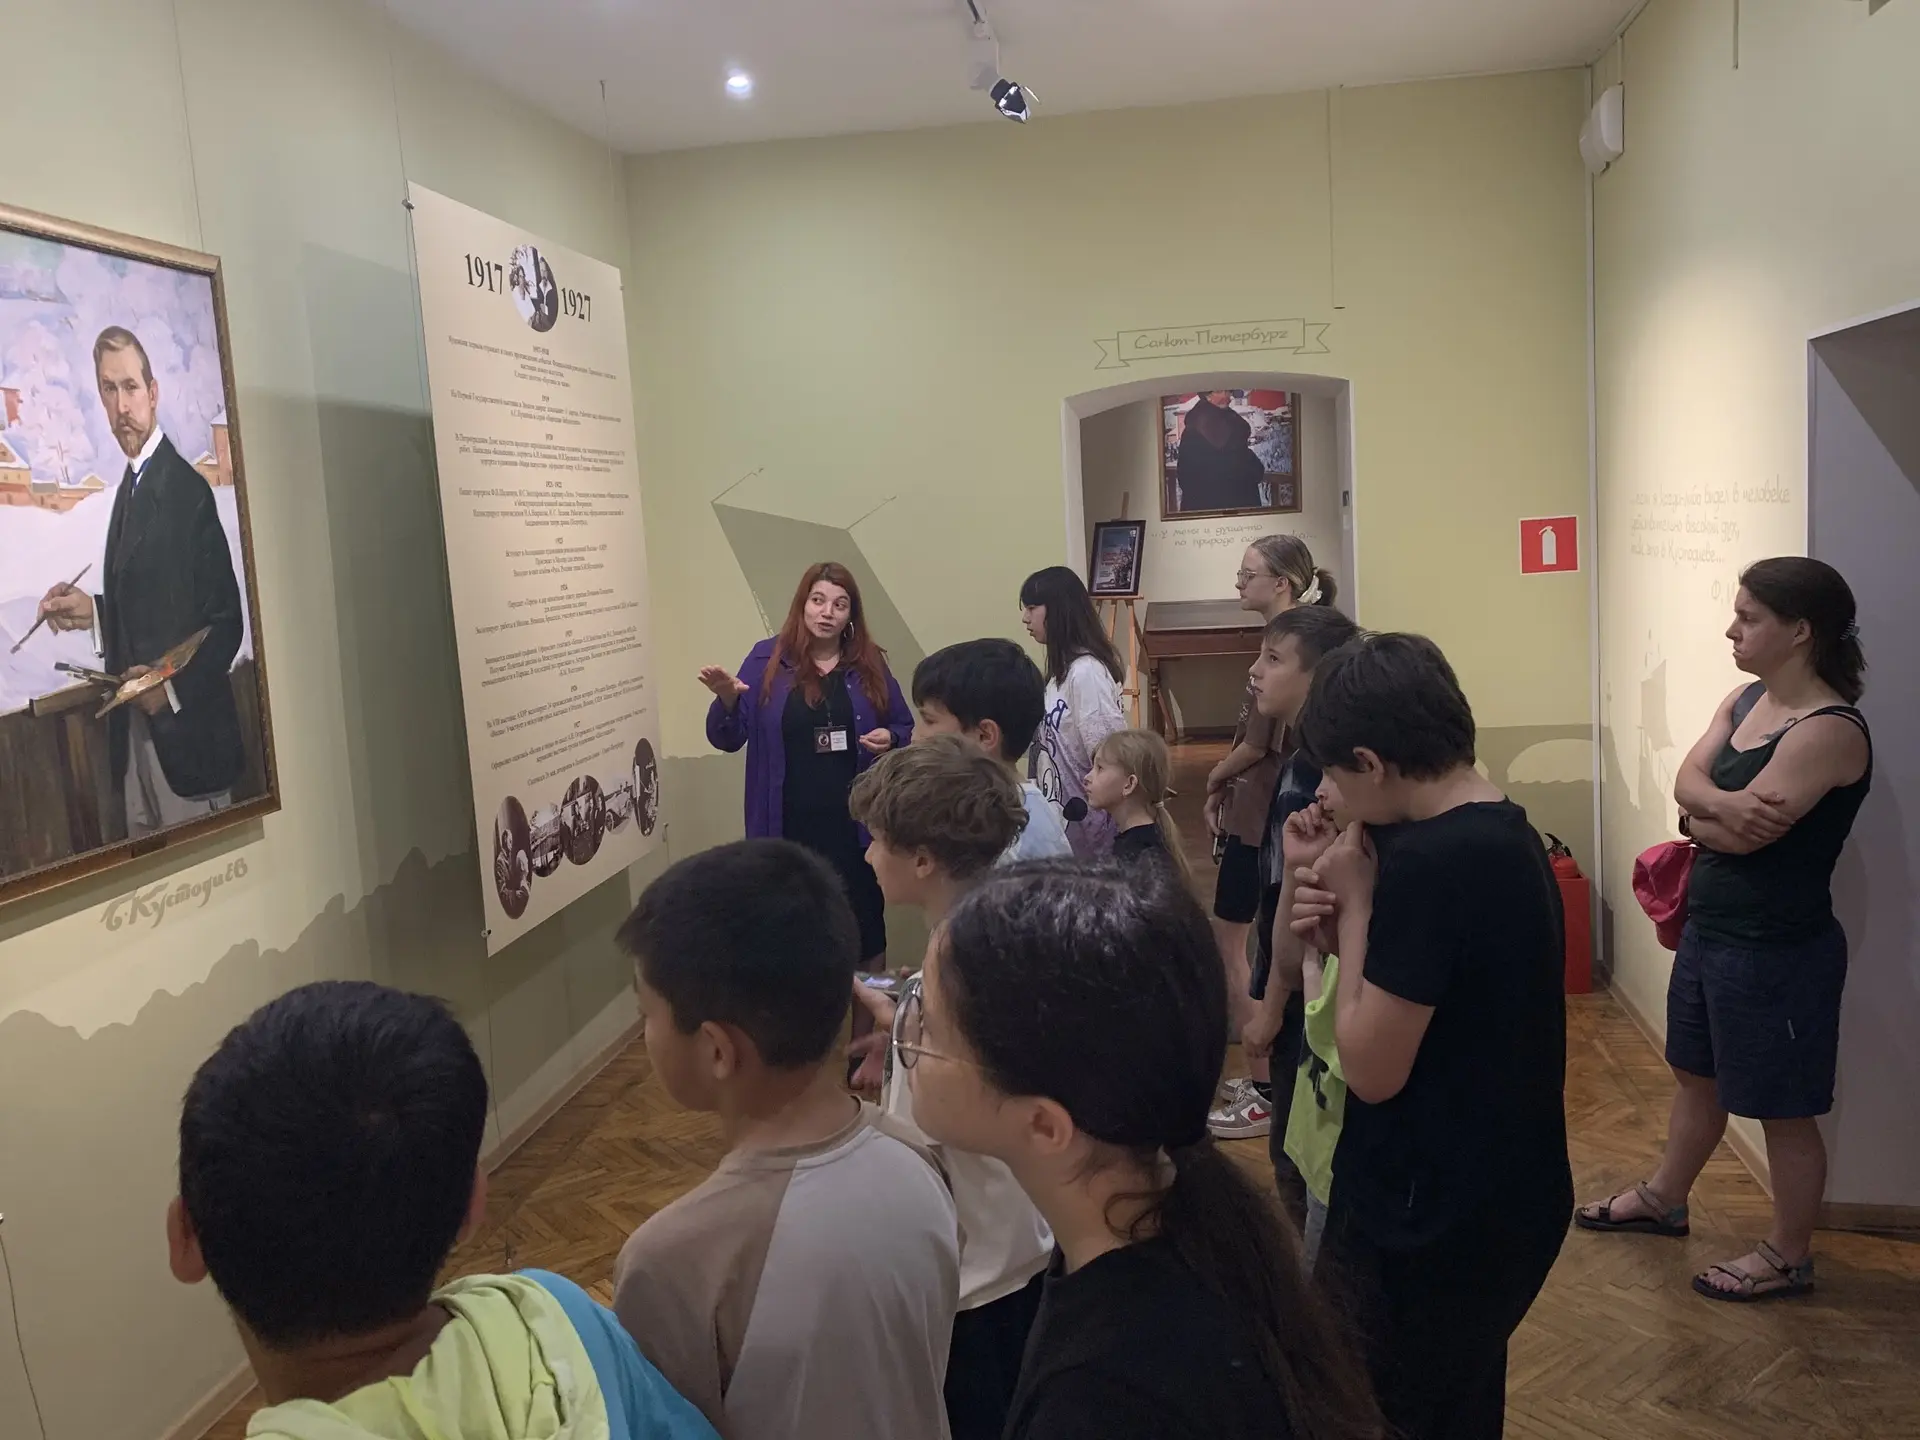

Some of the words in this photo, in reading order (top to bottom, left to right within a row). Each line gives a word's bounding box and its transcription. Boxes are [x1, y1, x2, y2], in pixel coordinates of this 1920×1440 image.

[464, 252, 504, 295] 1917
[560, 286, 592, 323] 1927
[1134, 326, 1290, 350] Санкт-Петербург
